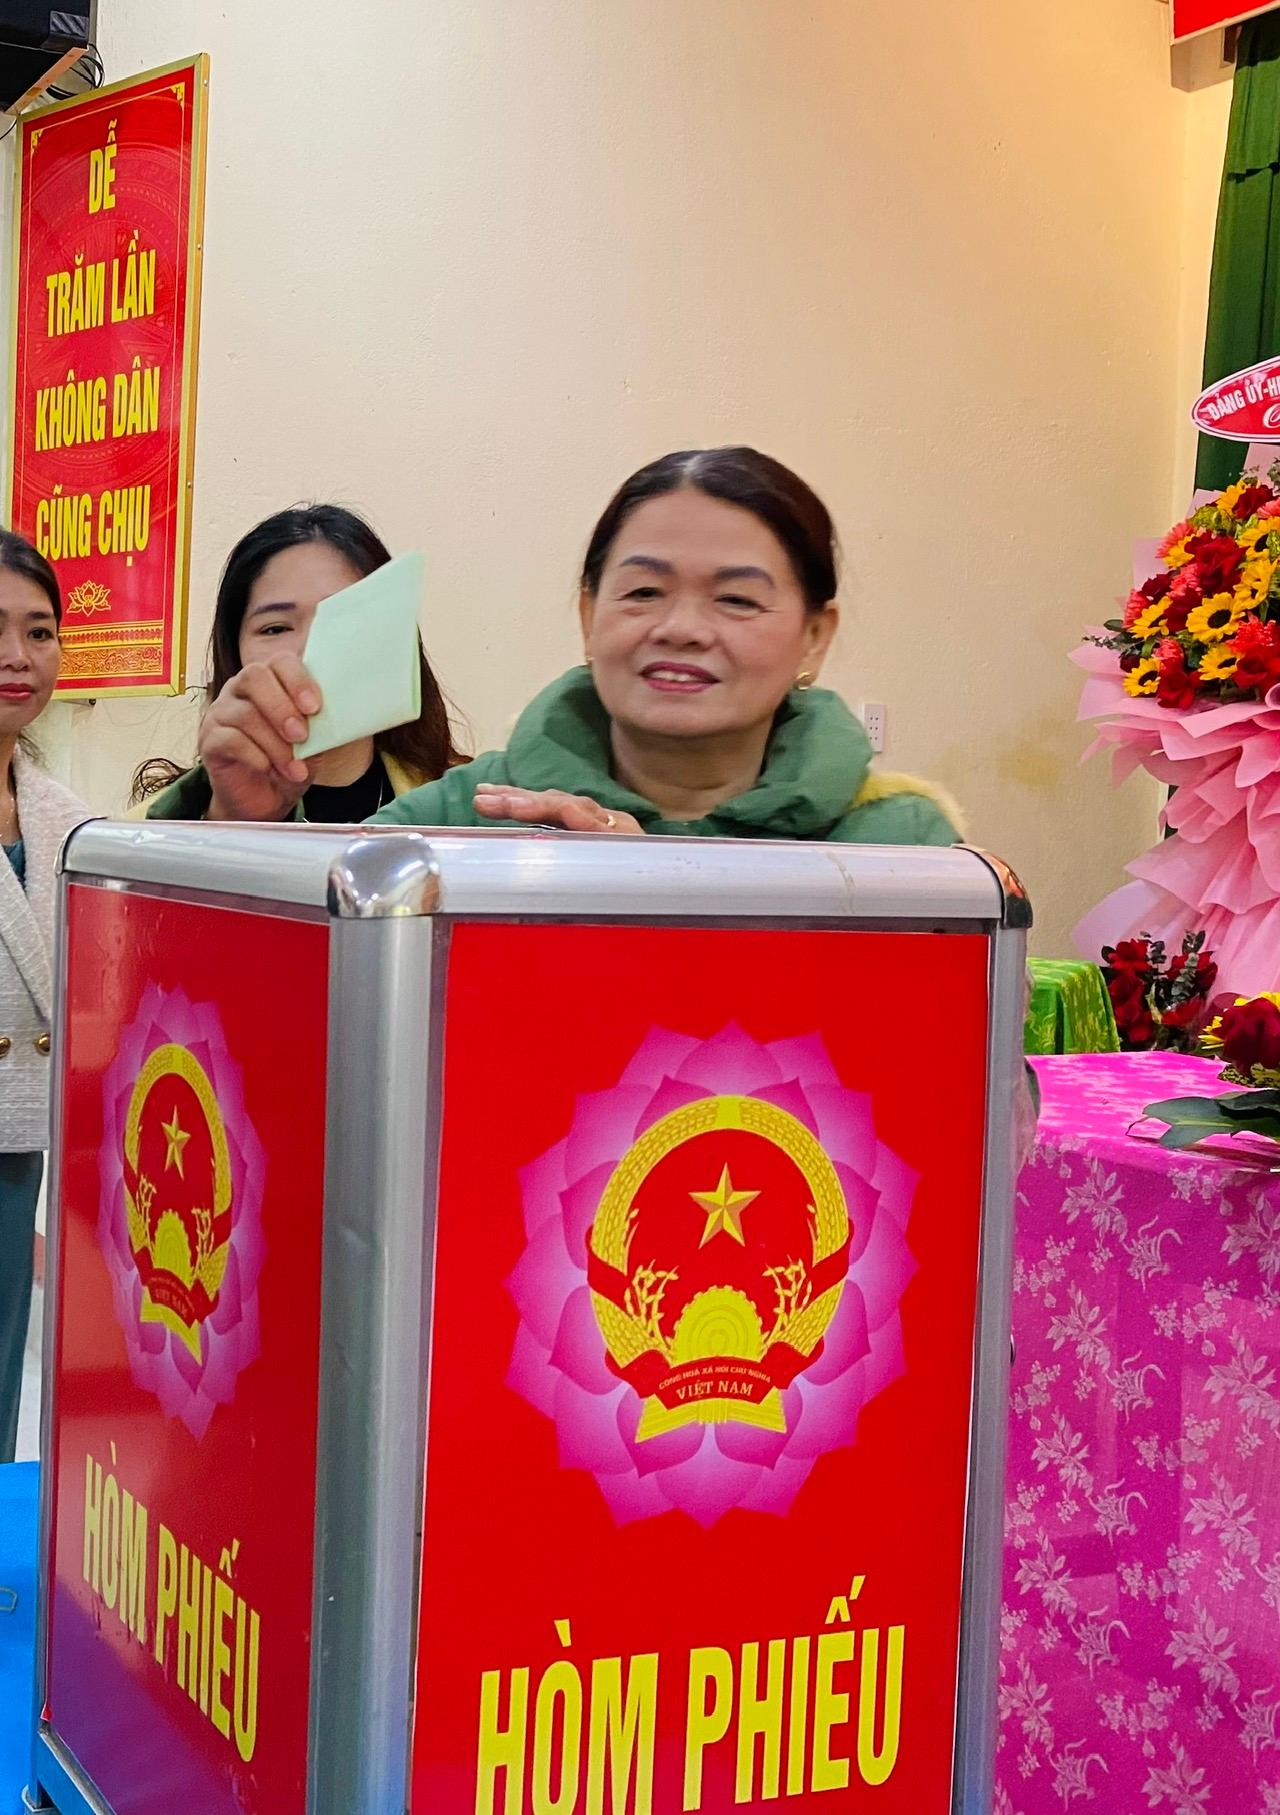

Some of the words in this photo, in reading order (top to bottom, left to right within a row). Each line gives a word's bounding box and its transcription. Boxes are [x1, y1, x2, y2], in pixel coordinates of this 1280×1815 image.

[88, 119, 117, 215] DỄ
[46, 254, 106, 338] TRĂM
[111, 231, 156, 324] LẦN
[35, 370, 108, 452] KHÔNG
[112, 355, 161, 438] DÂN
[36, 484, 93, 561] CŨNG
[98, 484, 151, 567] CHỊU
[675, 1379, 714, 1400] VIỆT
[717, 1380, 754, 1397] NAM
[83, 1440, 148, 1645] HÒM
[155, 1522, 261, 1763] PHIẾU
[474, 1618, 659, 1815] HÒM
[683, 1575, 905, 1812] PHIẾU
